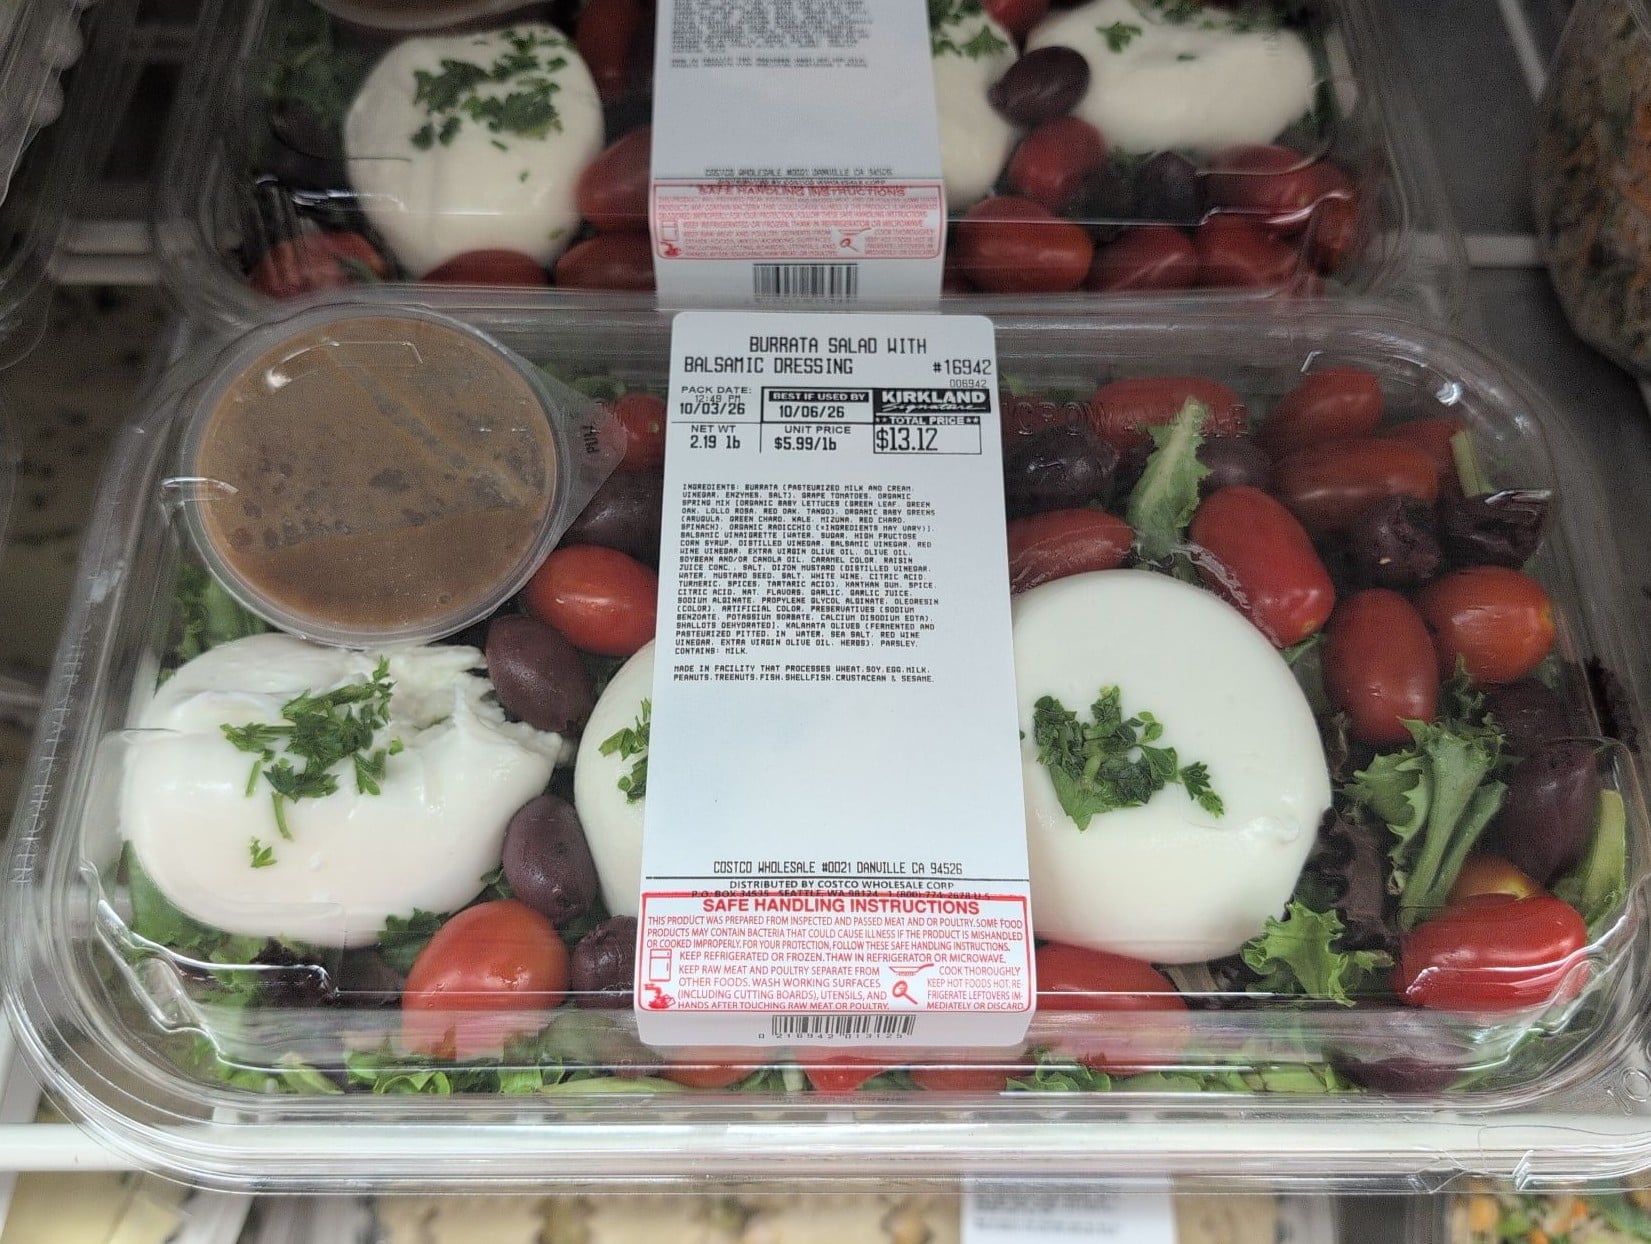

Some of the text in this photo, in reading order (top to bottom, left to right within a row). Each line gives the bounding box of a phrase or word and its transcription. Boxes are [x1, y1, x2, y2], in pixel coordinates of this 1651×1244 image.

[750, 336, 927, 355] BURRATA SALAD WITH
[684, 356, 853, 375] BALSAMIC DRESSING
[932, 359, 992, 375] #16942
[949, 379, 987, 388] 006942
[681, 386, 752, 394] PACK DATE:
[773, 392, 866, 401] BEST IF USED BY
[880, 390, 987, 404] KIRKLAND
[680, 402, 746, 416] 10/03/26
[780, 405, 845, 418] 10/06/26
[881, 402, 987, 414] Signature
[888, 416, 965, 425] TOTAL PRICE
[691, 425, 737, 434] NET WT
[784, 426, 852, 434] UNIT PRICE
[690, 436, 717, 449] 2.19
[875, 427, 938, 452] $13.12
[714, 861, 962, 875] COSTCO WHOLESALE #0021 DANVILLE CA 94526
[730, 881, 954, 890] DISTRIBUTED BY COSTCO WHOLESALE CORP
[703, 898, 980, 914] SAFE HANDLING INSTRUCTIONS
[648, 916, 665, 925] THIS
[667, 917, 706, 926] PRODUCT
[706, 917, 724, 926] WAS
[726, 917, 763, 926] PREPARED
[765, 917, 789, 927] FROM
[790, 918, 833, 927] INSPECTED
[834, 918, 851, 927] AND
[854, 918, 882, 927] PASSED
[885, 919, 905, 928] MEAT
[908, 919, 924, 928] AND
[926, 919, 938, 928] OR
[1000, 920, 1022, 929] FOOD
[647, 928, 1023, 940] PRODUCTS MAY CONTAIN BACTERIA THAT COULD CAUSE ILLNESS IF THE PRODUCT IS MISHANDLED
[647, 940, 657, 948] OR
[659, 940, 692, 949] COOKED
[742, 941, 757, 949] FOR
[759, 941, 780, 949] YOUR
[832, 941, 865, 950] FOLLOW
[866, 942, 889, 950] THESE
[890, 942, 910, 950] SAFE
[911, 942, 951, 951] HANDLING
[680, 952, 701, 961] KEEP
[703, 952, 769, 961] REFRIGERATED
[771, 952, 784, 961] OR
[826, 953, 851, 962] THAW
[854, 953, 864, 962] IN
[866, 953, 932, 962] REFRIGERATOR
[934, 953, 947, 963] OR
[679, 966, 880, 976] KEEP RAW MEAT AND POULTRY SEPARATE FROM
[939, 966, 1020, 976] COOK THOROUGHLY
[679, 978, 710, 987] OTHER
[752, 978, 780, 987] WASH
[781, 978, 830, 987] WORKING
[832, 979, 881, 988] SURFACES
[927, 979, 945, 988] KEEP
[948, 979, 963, 988] HOT
[965, 979, 992, 988] FOODS
[678, 990, 731, 1000] (INCLUDING
[734, 990, 773, 1000] CUTTING
[821, 990, 865, 1000] UTENSILS,
[867, 990, 887, 1000] AND
[927, 991, 967, 1000] FRIGERATE
[968, 991, 1010, 1000] LEFTOVERS
[788, 1002, 807, 1010] RAW
[810, 1002, 834, 1010] MEAT
[835, 1002, 847, 1010] OR
[927, 1002, 971, 1010] MEDIATELY
[973, 1002, 985, 1010] OR
